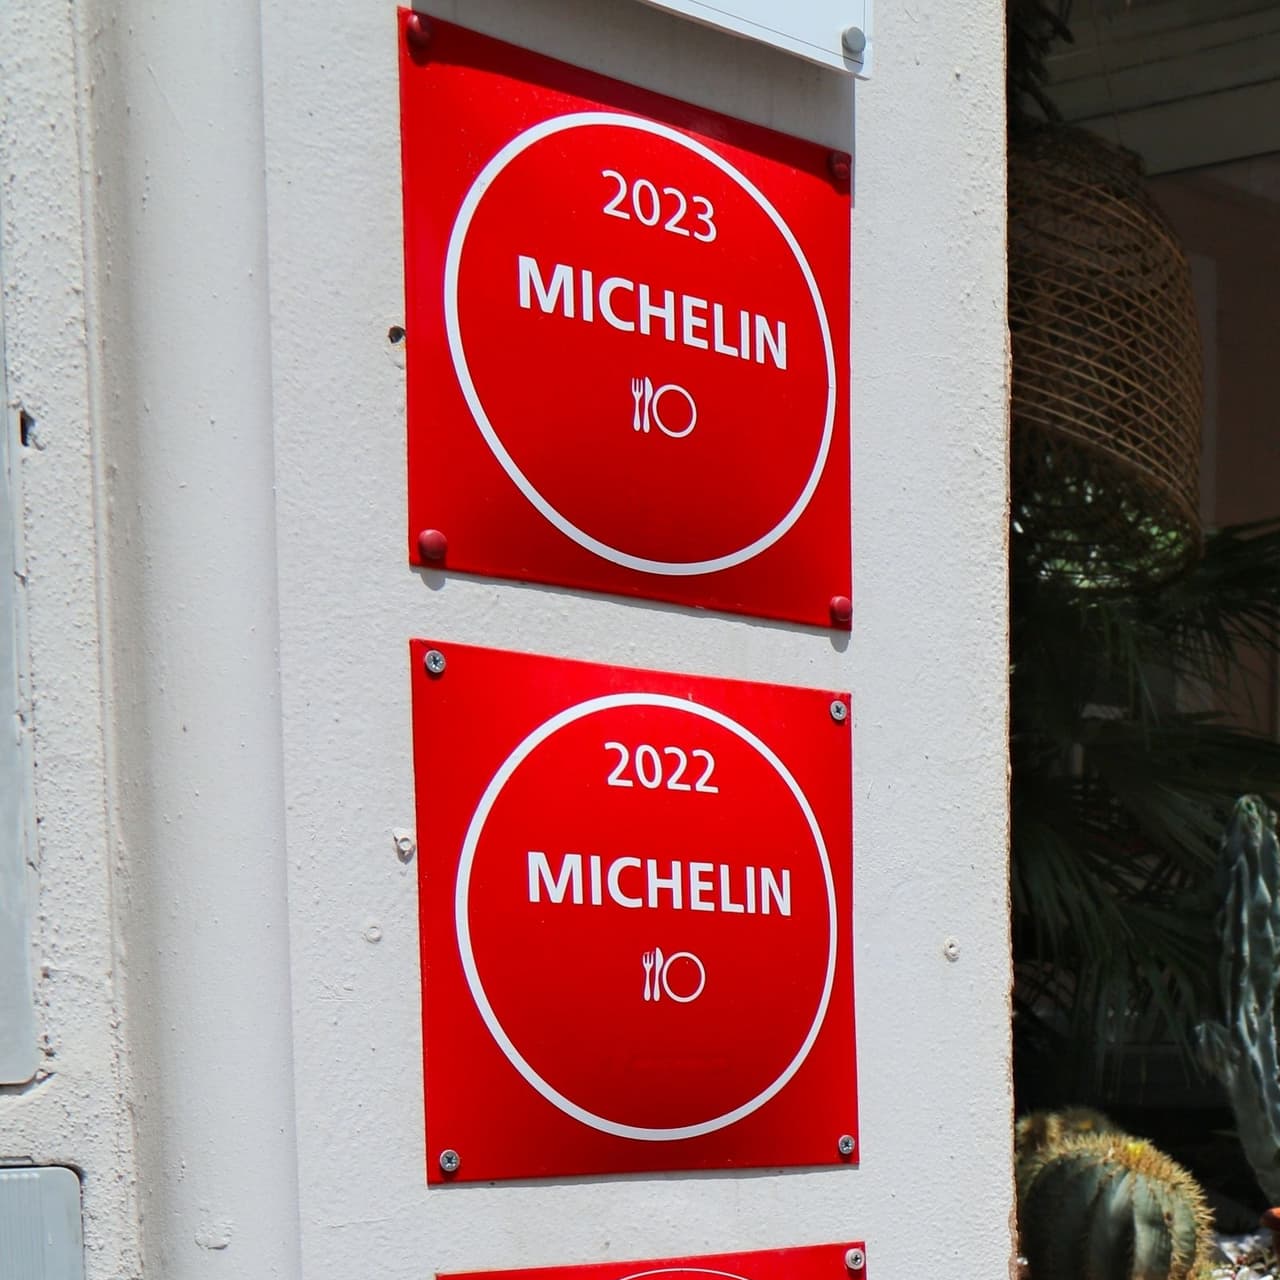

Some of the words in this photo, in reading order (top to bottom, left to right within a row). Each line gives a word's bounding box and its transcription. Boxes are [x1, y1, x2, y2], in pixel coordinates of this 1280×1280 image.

[602, 169, 717, 243] 2023
[518, 255, 787, 370] MICHELIN
[604, 741, 719, 794] 2022
[527, 851, 791, 917] MICHELIN
